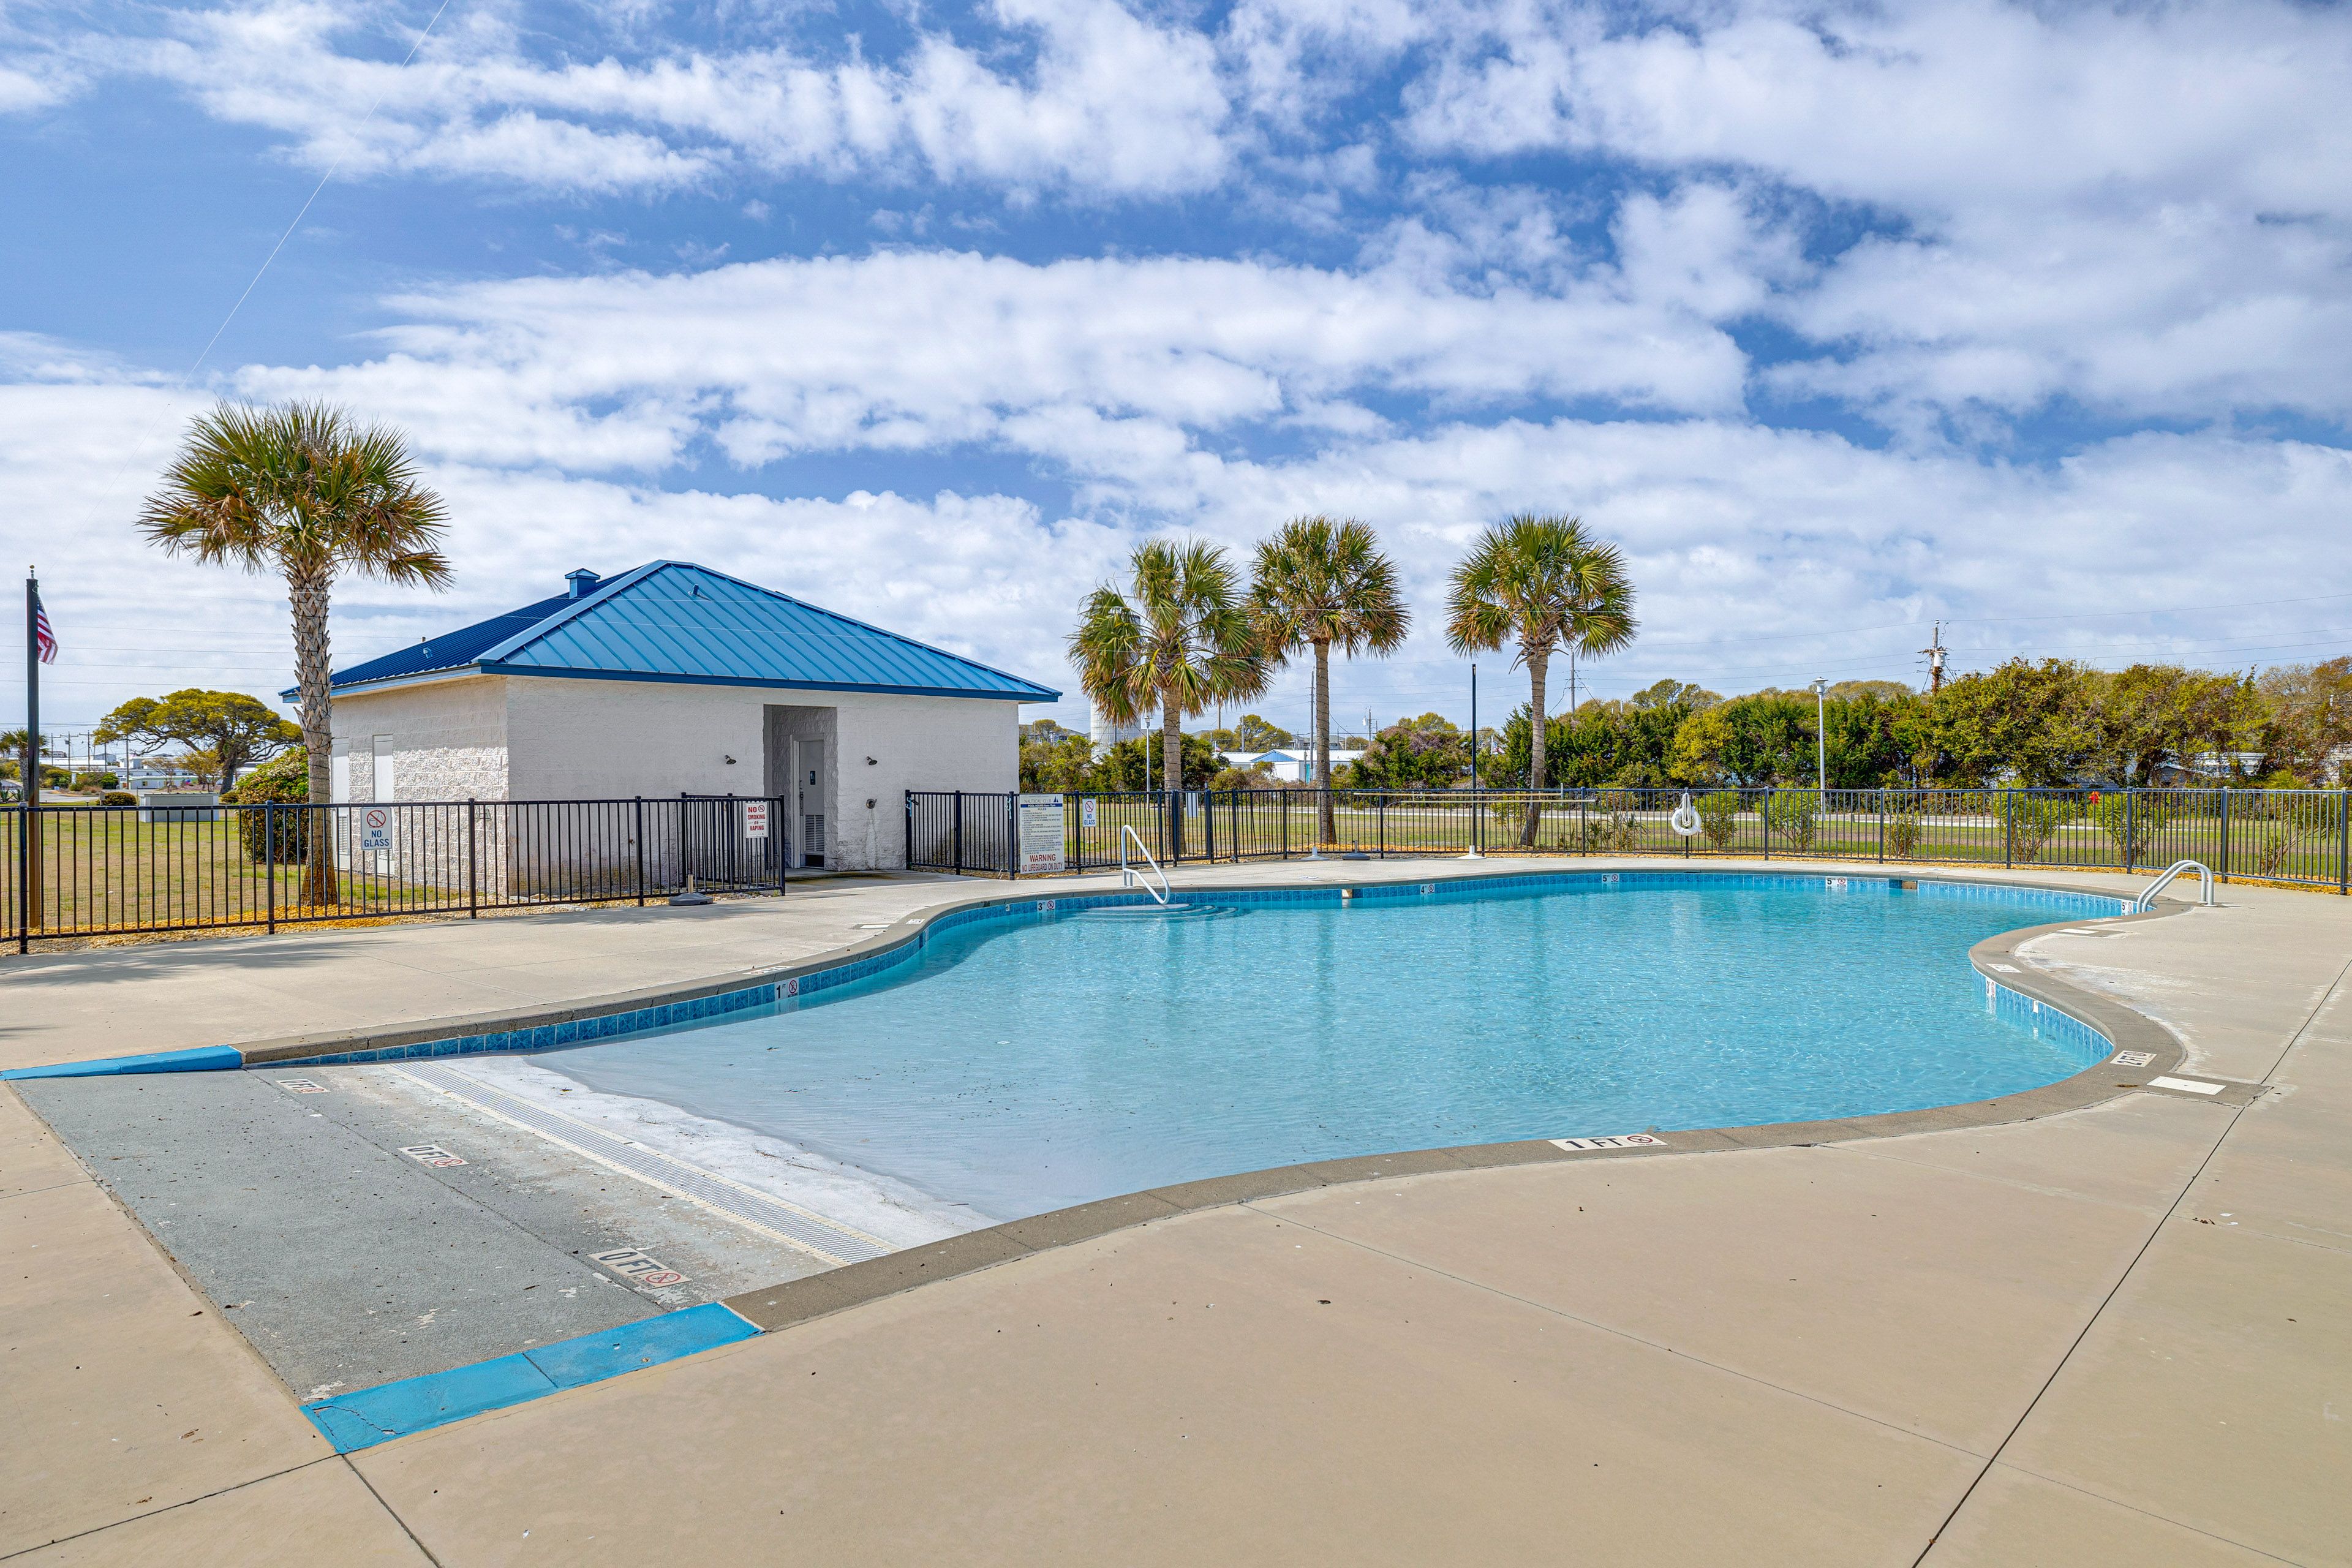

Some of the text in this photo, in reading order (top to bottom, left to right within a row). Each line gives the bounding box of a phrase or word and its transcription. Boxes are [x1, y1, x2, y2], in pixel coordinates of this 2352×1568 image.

[364, 839, 390, 847] GLASS
[1030, 853, 1056, 862] WARNING
[1028, 863, 1047, 872] LIFEGUARD
[1038, 902, 1042, 911] 3
[2122, 902, 2125, 911] 5
[776, 985, 781, 999] 1
[1589, 1138, 1623, 1147] FT
[598, 1251, 663, 1274] 0 FT
